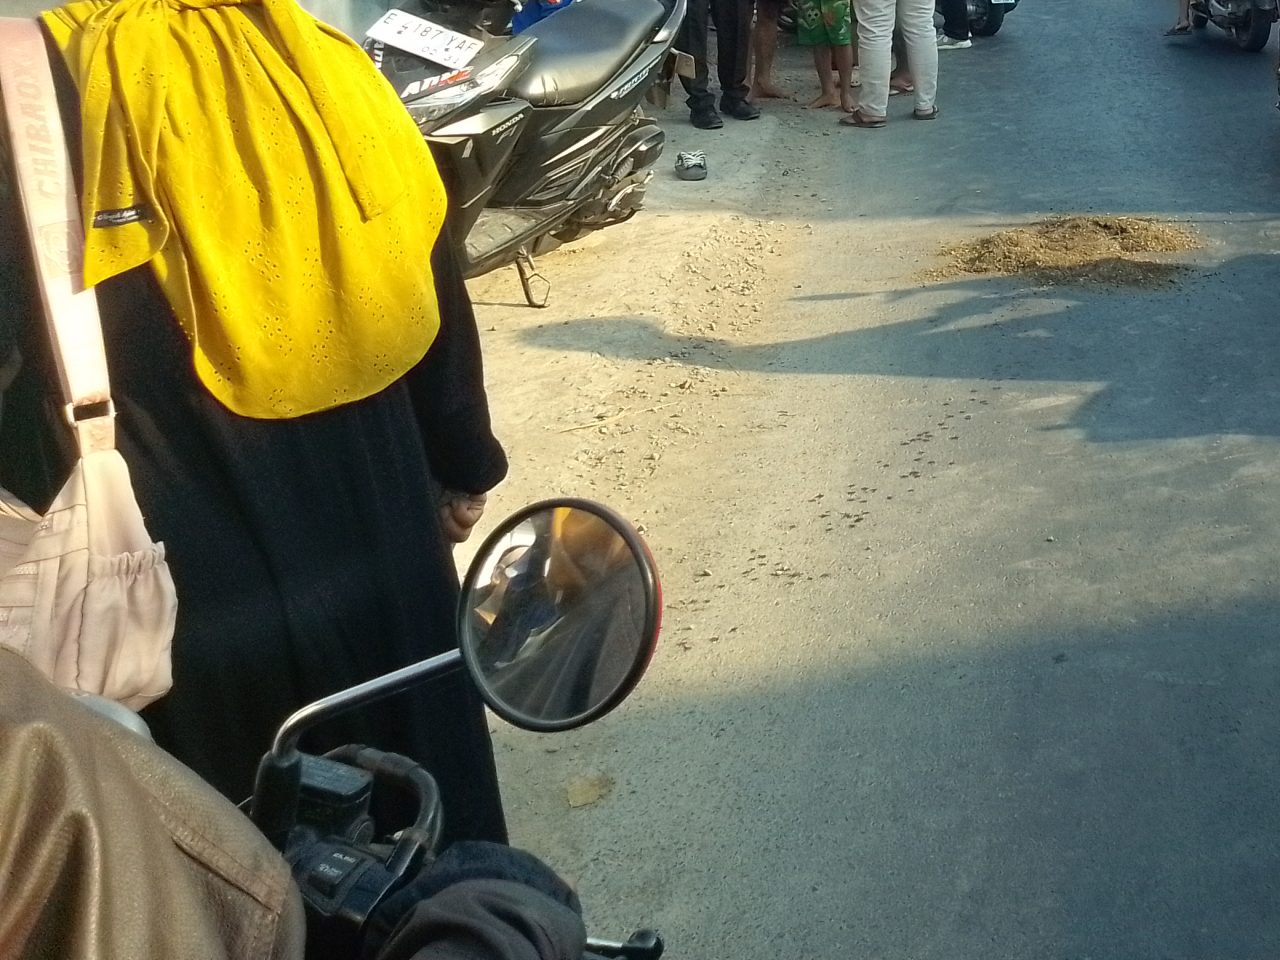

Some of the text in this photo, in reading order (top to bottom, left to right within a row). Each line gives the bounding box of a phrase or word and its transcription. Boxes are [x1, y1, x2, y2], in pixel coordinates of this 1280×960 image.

[384, 12, 398, 25] E
[445, 34, 478, 52] YAF
[492, 112, 525, 137] HONDA
